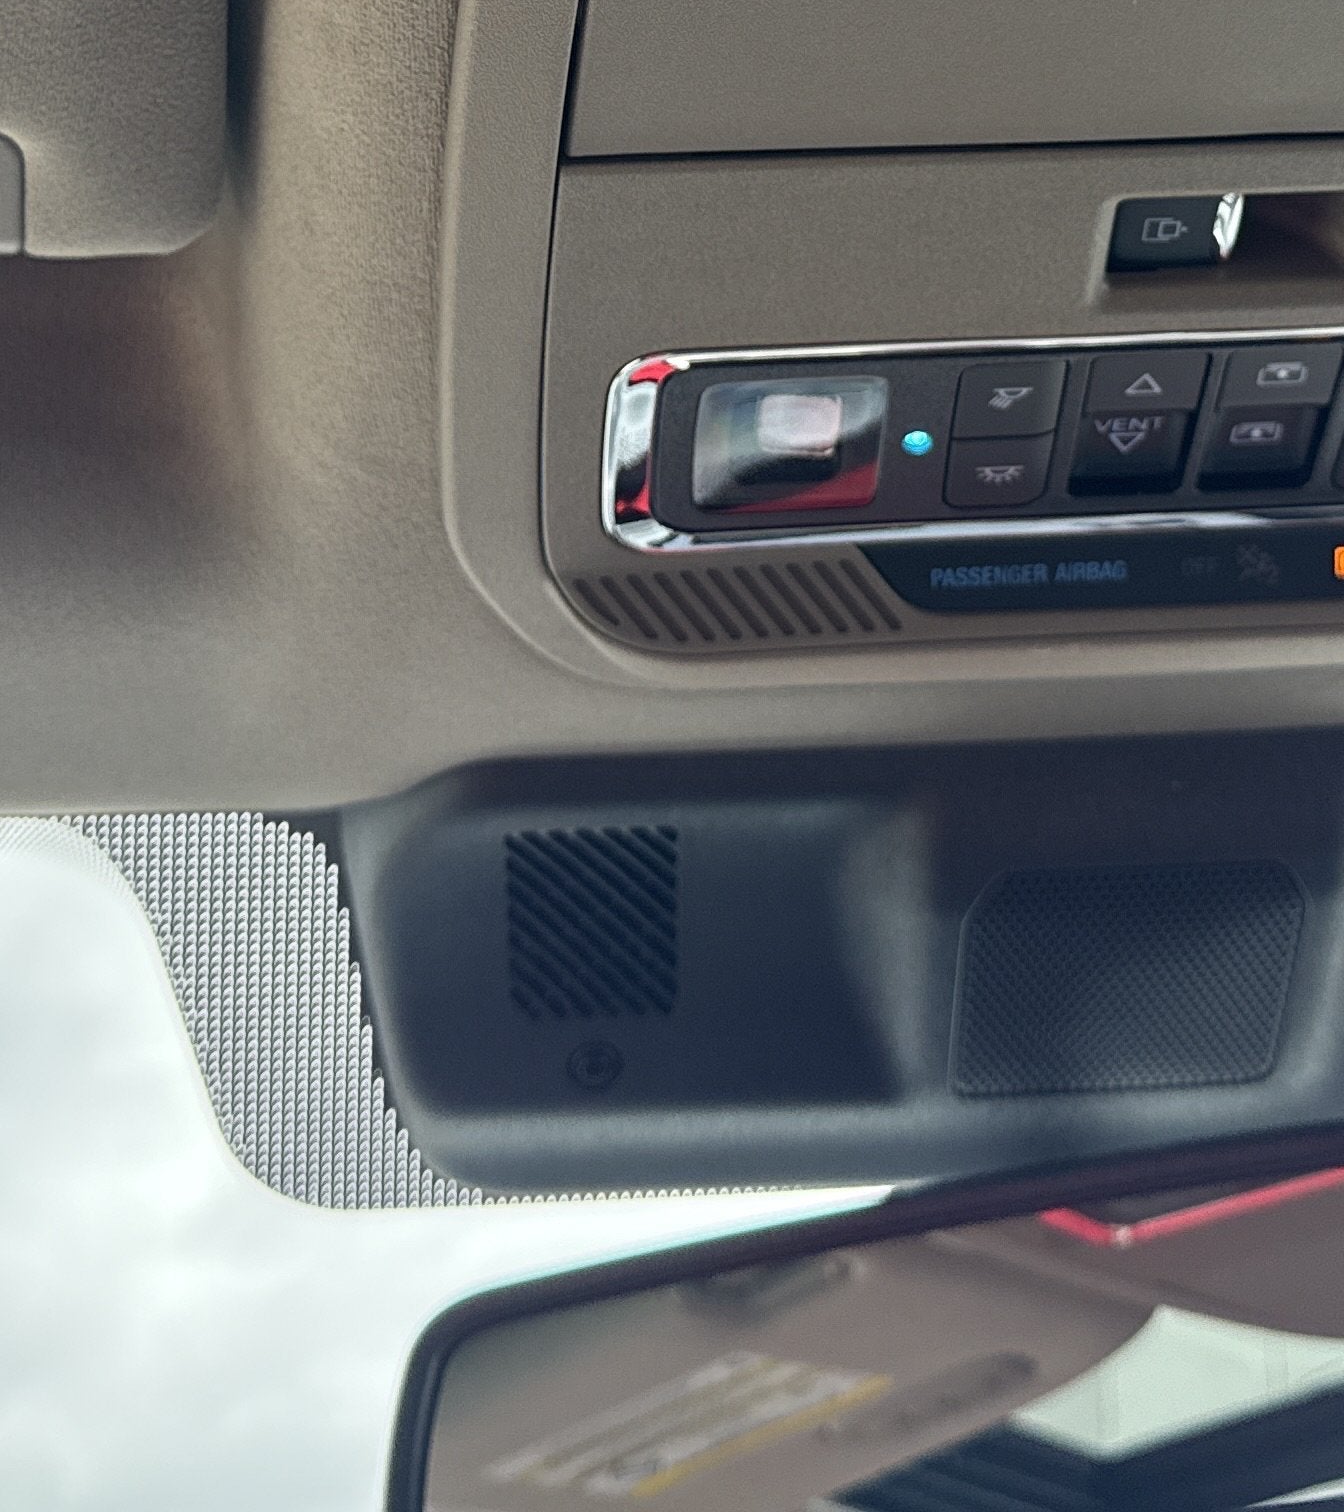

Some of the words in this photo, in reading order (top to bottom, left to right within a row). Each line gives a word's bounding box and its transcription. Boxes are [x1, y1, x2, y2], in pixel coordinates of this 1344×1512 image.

[1093, 415, 1166, 435] VENT
[929, 563, 1049, 588] PASSENGER
[1054, 560, 1129, 583] AIRBAG
